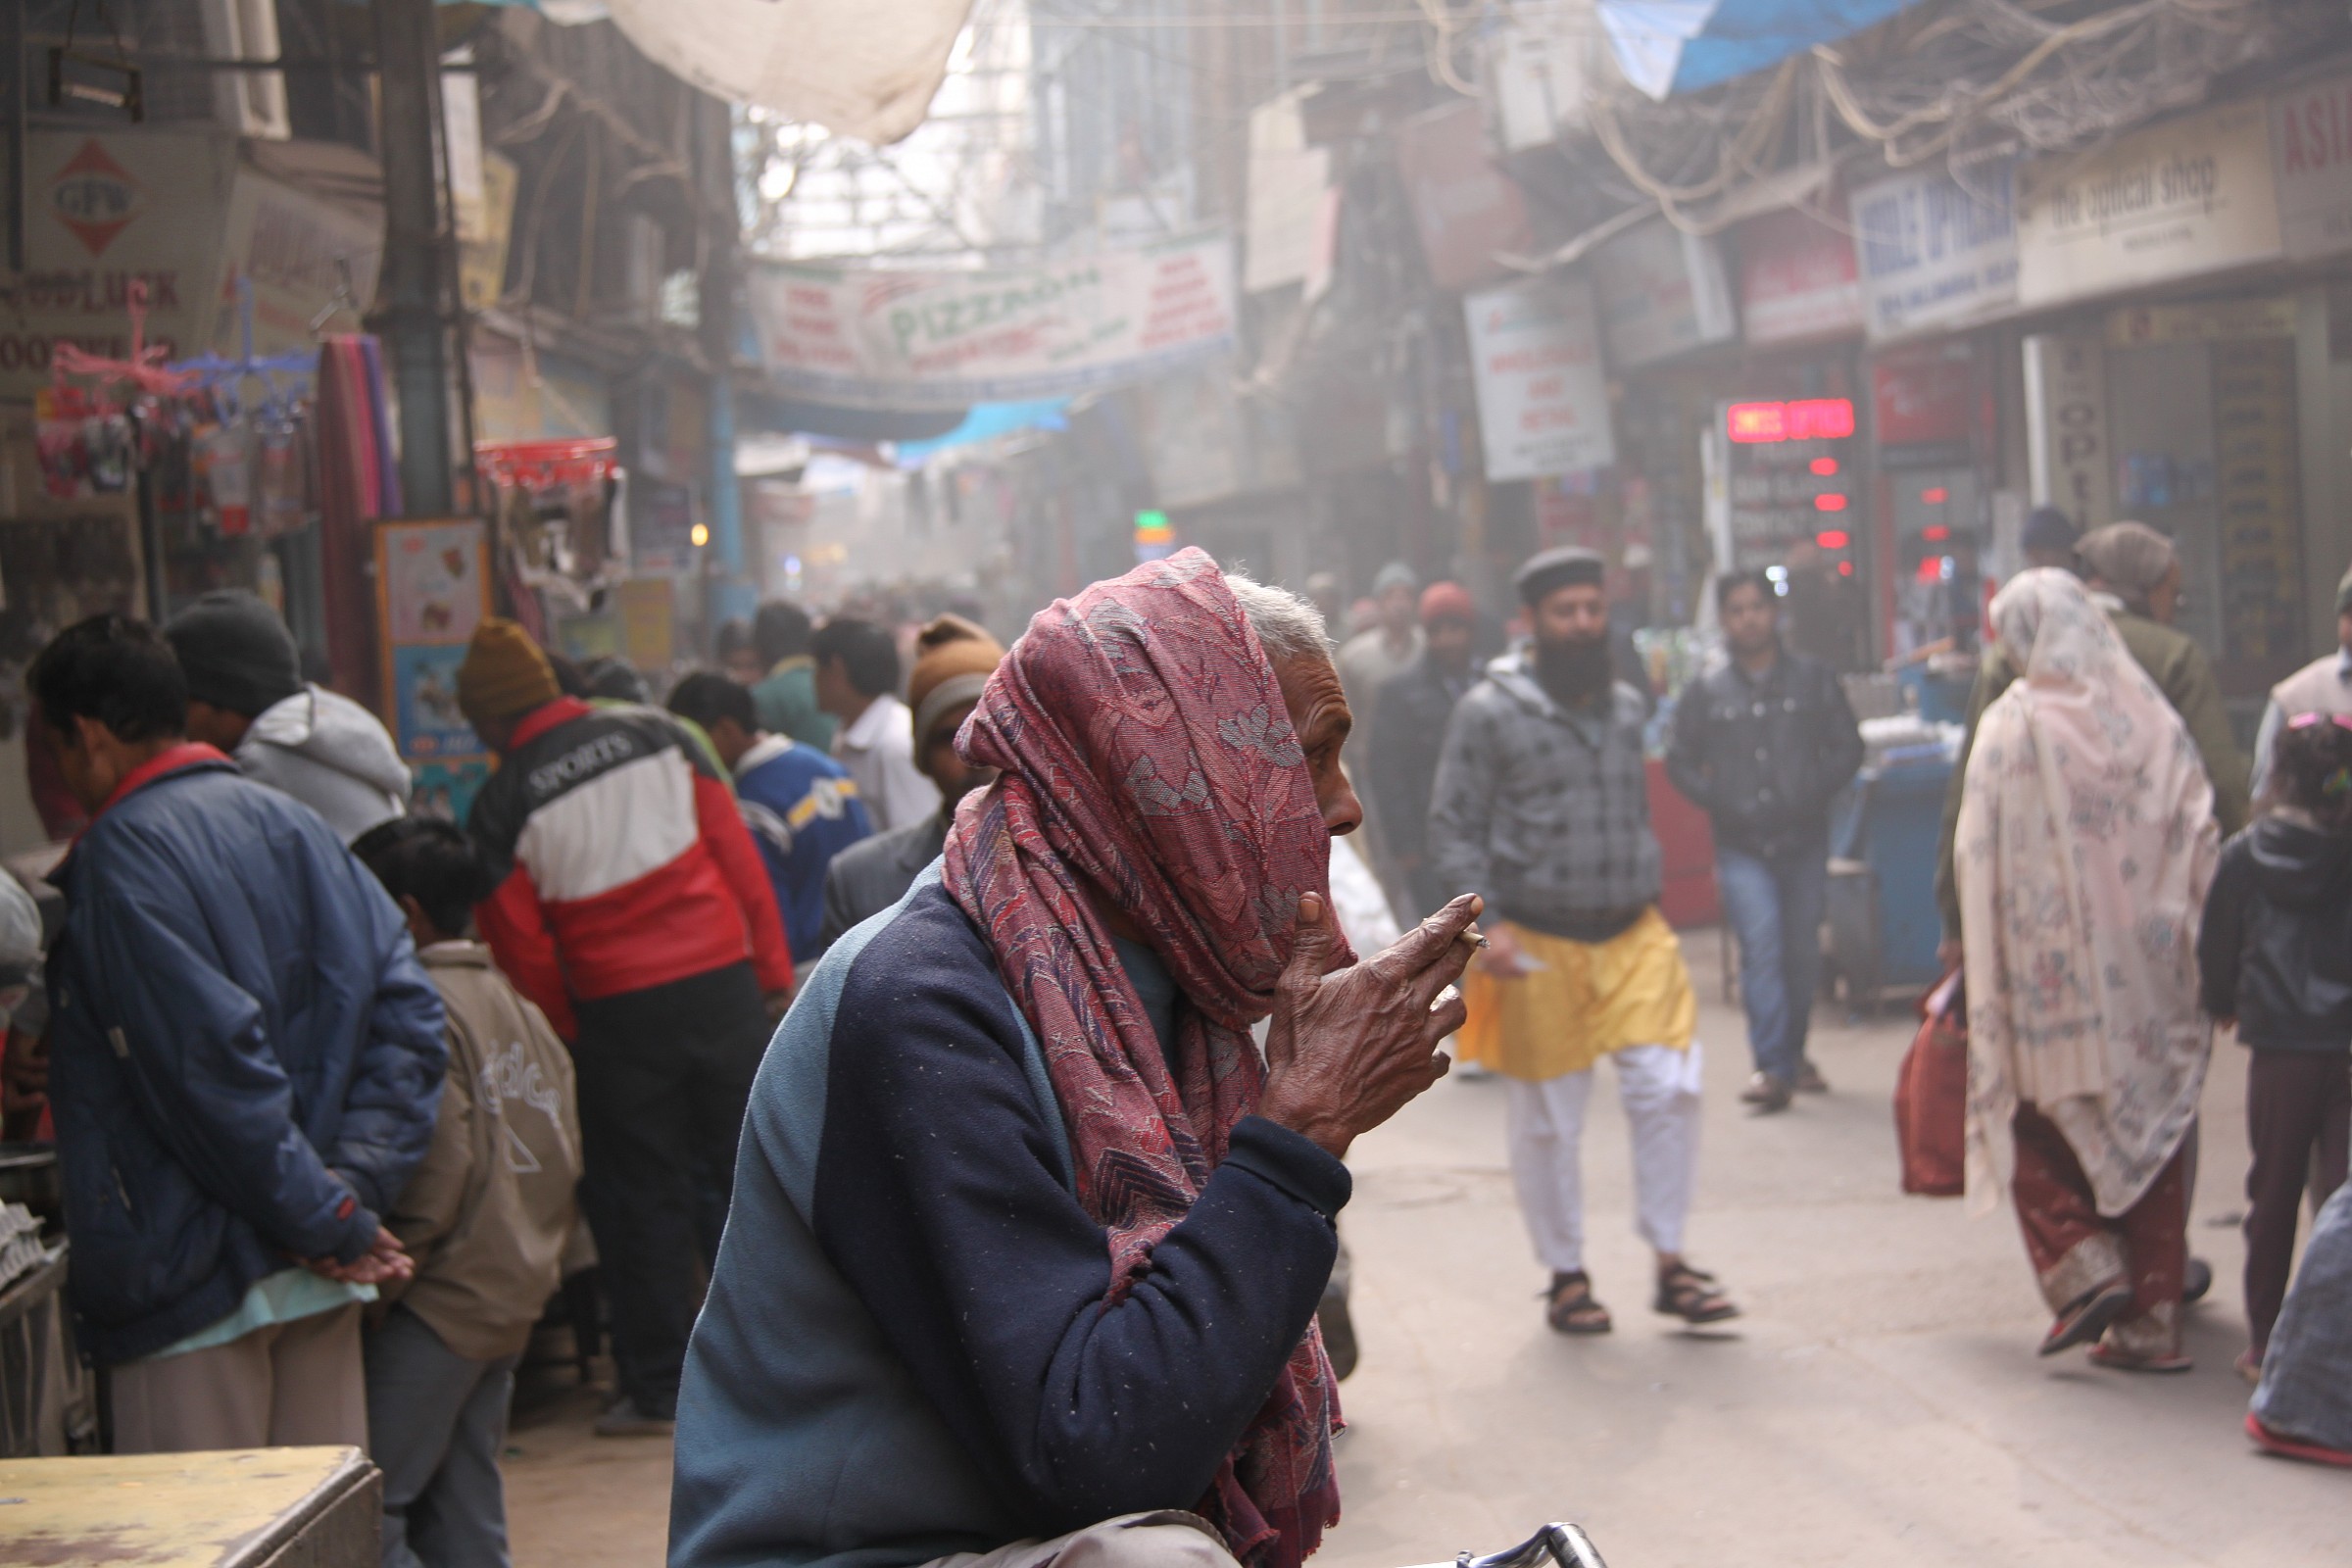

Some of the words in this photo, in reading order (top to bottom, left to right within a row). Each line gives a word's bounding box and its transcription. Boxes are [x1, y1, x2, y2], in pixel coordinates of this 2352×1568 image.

[2086, 157, 2153, 238] optical
[2160, 151, 2219, 218] shop
[529, 730, 633, 797] SPORTS
